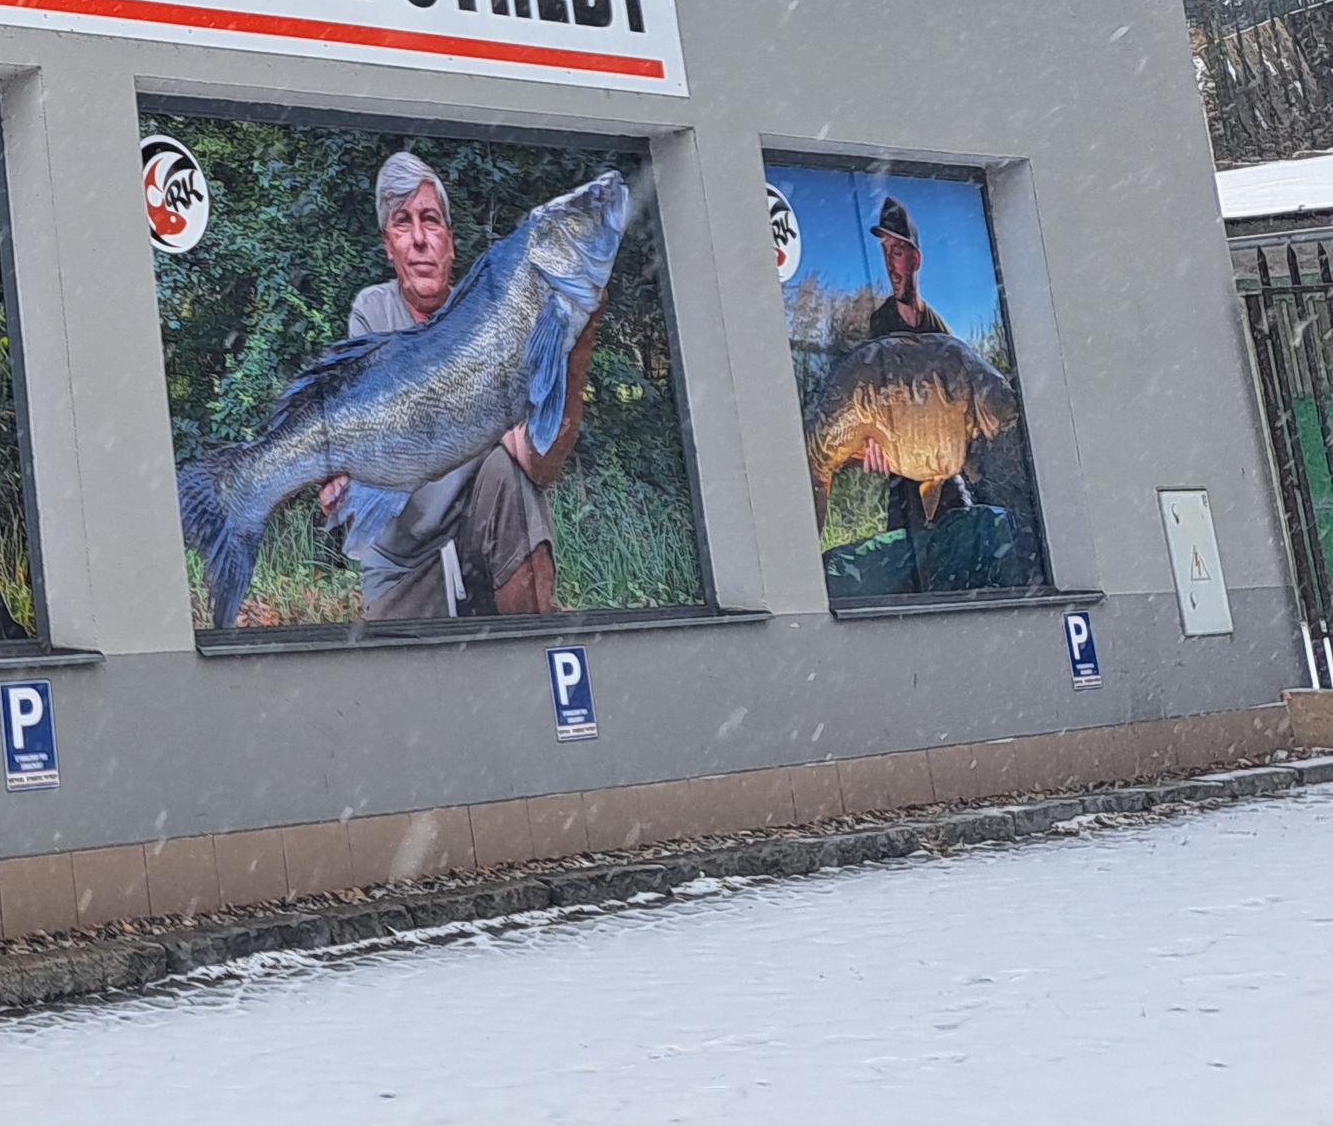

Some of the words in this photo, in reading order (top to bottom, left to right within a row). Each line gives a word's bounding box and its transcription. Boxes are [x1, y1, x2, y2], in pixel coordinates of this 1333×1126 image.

[164, 170, 205, 213] RK
[1067, 615, 1088, 660] P
[553, 652, 581, 705] P
[8, 687, 44, 750] P
